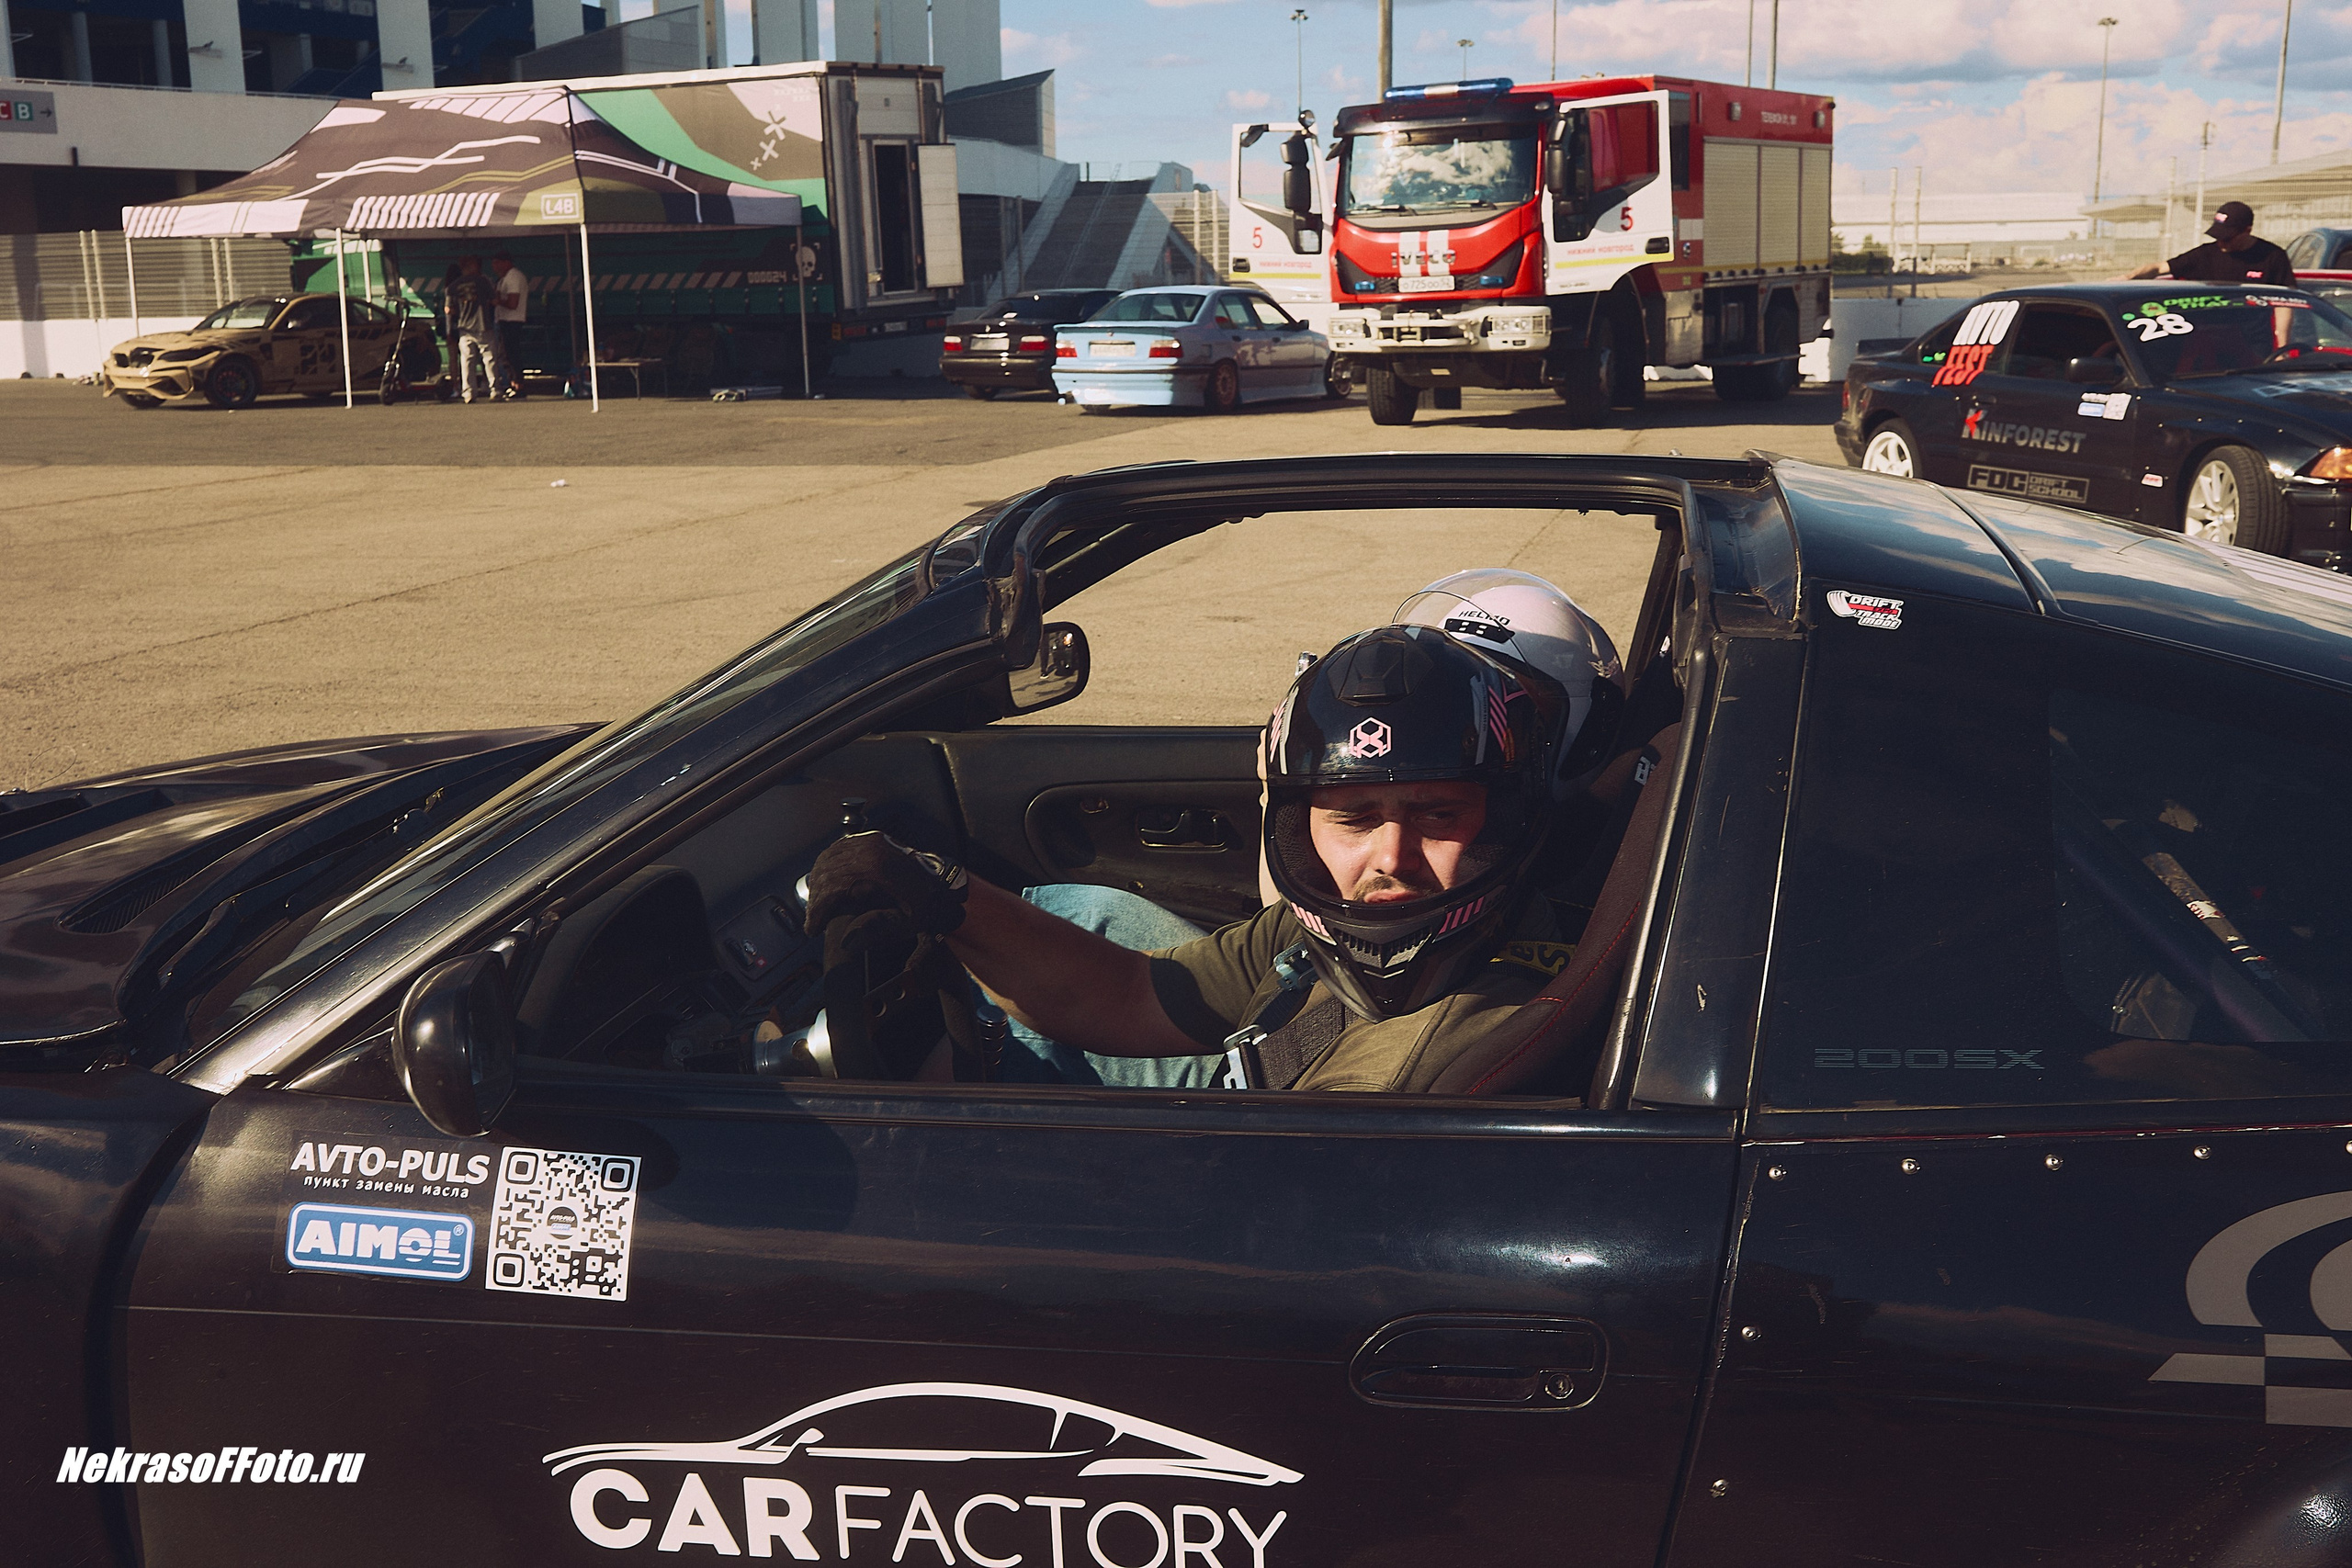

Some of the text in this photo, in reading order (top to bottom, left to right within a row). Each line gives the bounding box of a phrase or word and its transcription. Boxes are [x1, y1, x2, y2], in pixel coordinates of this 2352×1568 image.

[17, 103, 30, 119] B
[546, 197, 573, 215] L4B
[1621, 207, 1634, 231] 5
[1253, 227, 1262, 248] 5
[1391, 249, 1456, 267] IVECO
[1952, 300, 2019, 345] AVTO
[2127, 313, 2194, 342] 28
[1932, 344, 1995, 386] FEST
[1962, 408, 2086, 454] KINFOREST
[2029, 484, 2083, 499] SCHOOL
[2030, 476, 2068, 488] DRIFT
[1849, 595, 1899, 610] DRIFT
[1856, 610, 1898, 621] TRACK
[1860, 617, 1899, 627] MODE
[1815, 1048, 2045, 1069] 200SX
[290, 1142, 491, 1185] AVTO-PULS
[303, 1176, 349, 1190] пункт
[296, 1220, 461, 1266] AIMOL
[570, 1468, 1287, 1568] CAR FACTORY
